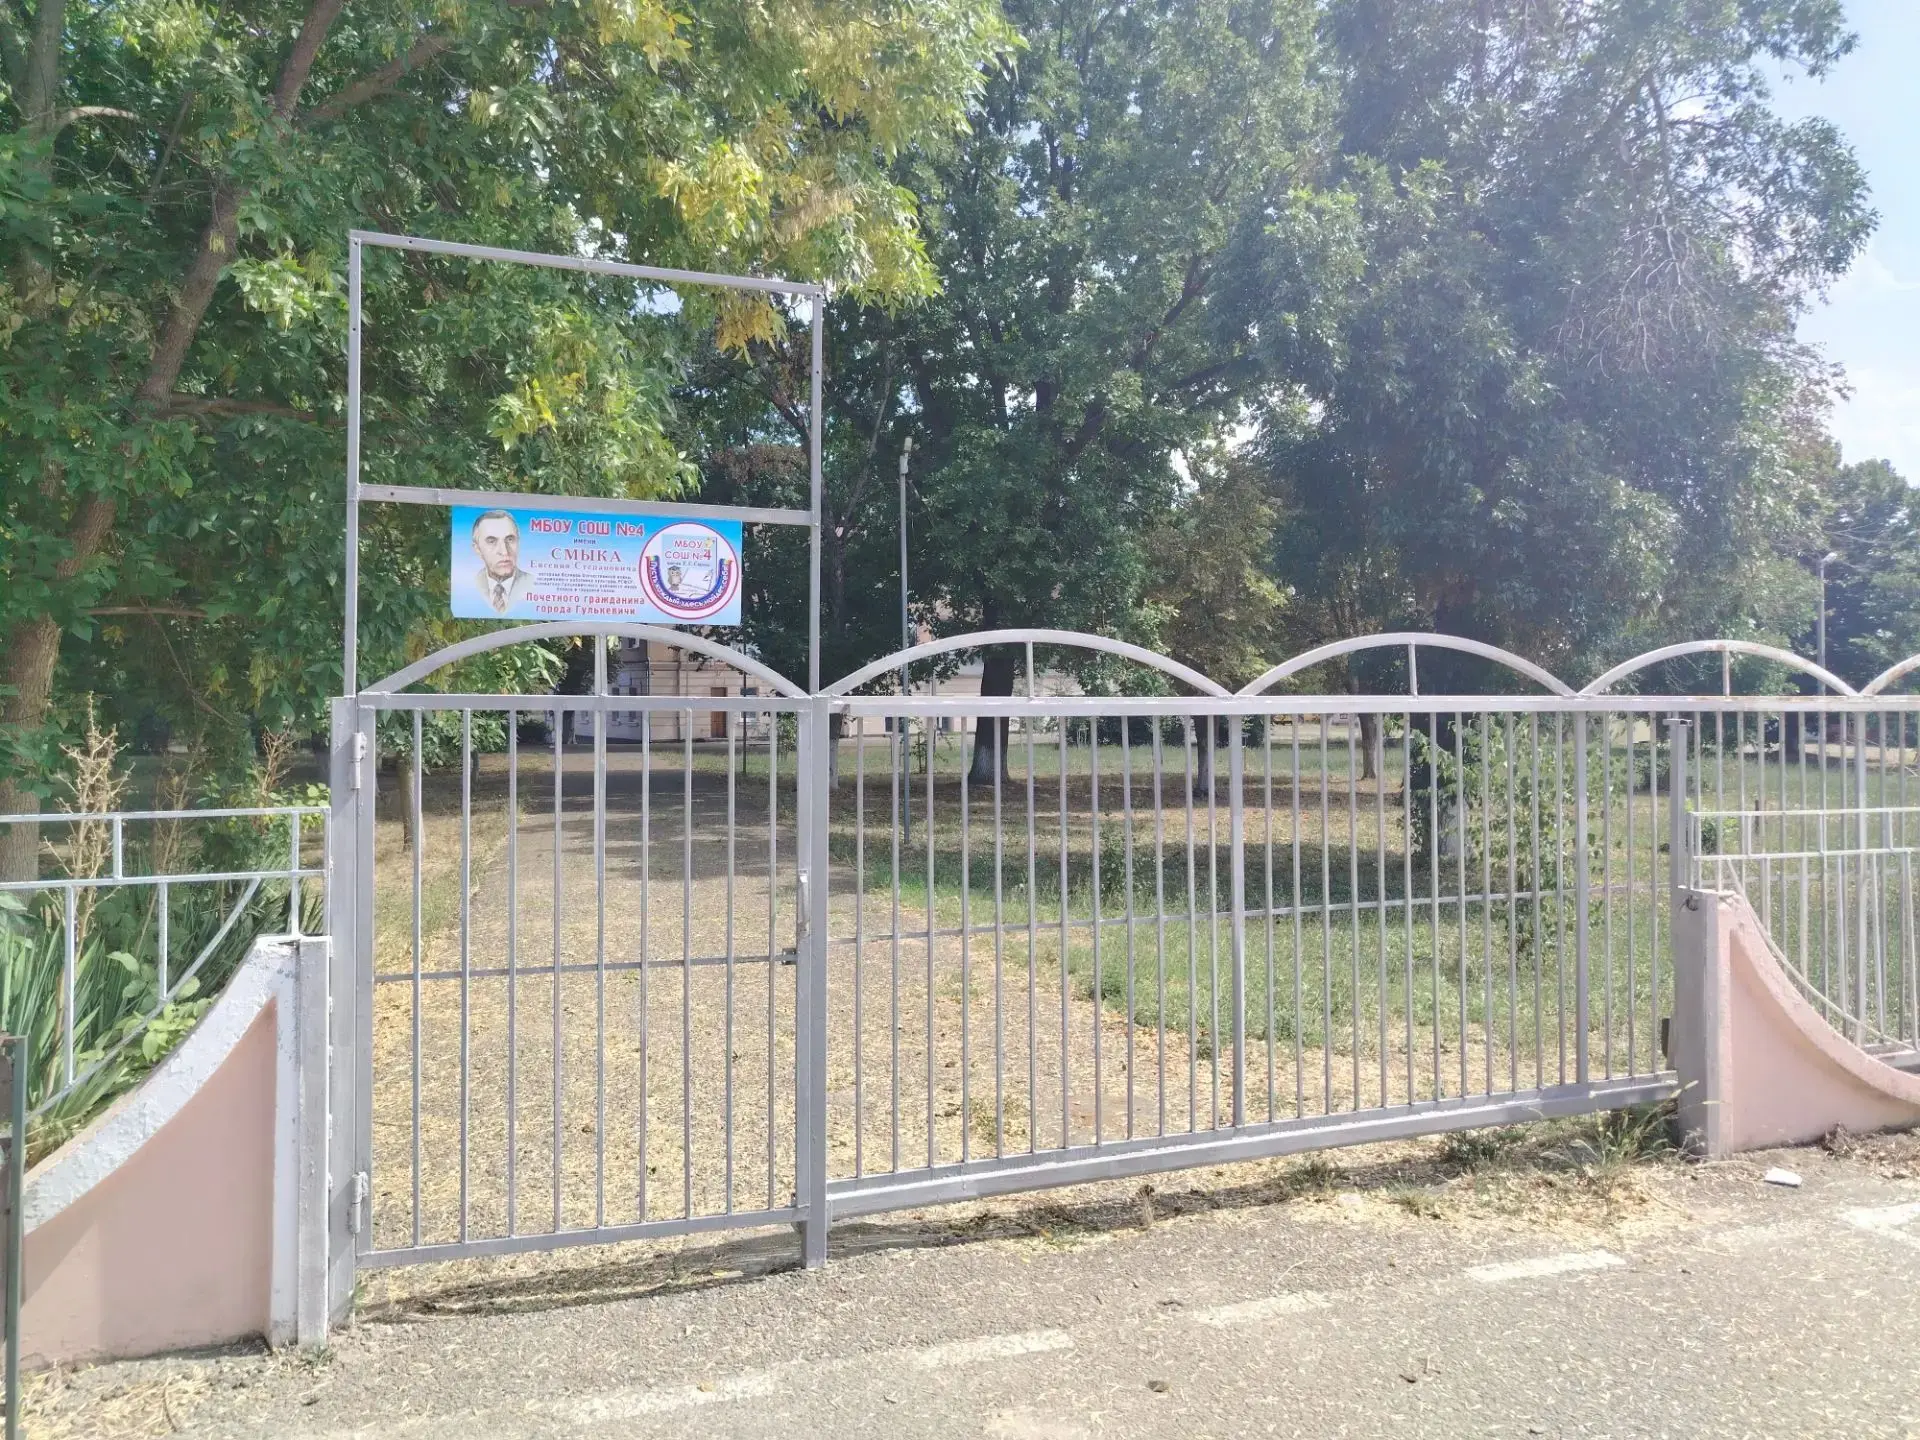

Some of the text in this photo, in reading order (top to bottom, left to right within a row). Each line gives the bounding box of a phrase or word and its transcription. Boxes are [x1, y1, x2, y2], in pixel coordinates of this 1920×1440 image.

[531, 518, 645, 537] МБОУ СОШ №4
[674, 540, 702, 549] МБОУ
[551, 547, 622, 562] СМЫКА
[664, 550, 689, 560] СОШ
[526, 592, 580, 603] Почетного
[536, 605, 571, 615] города
